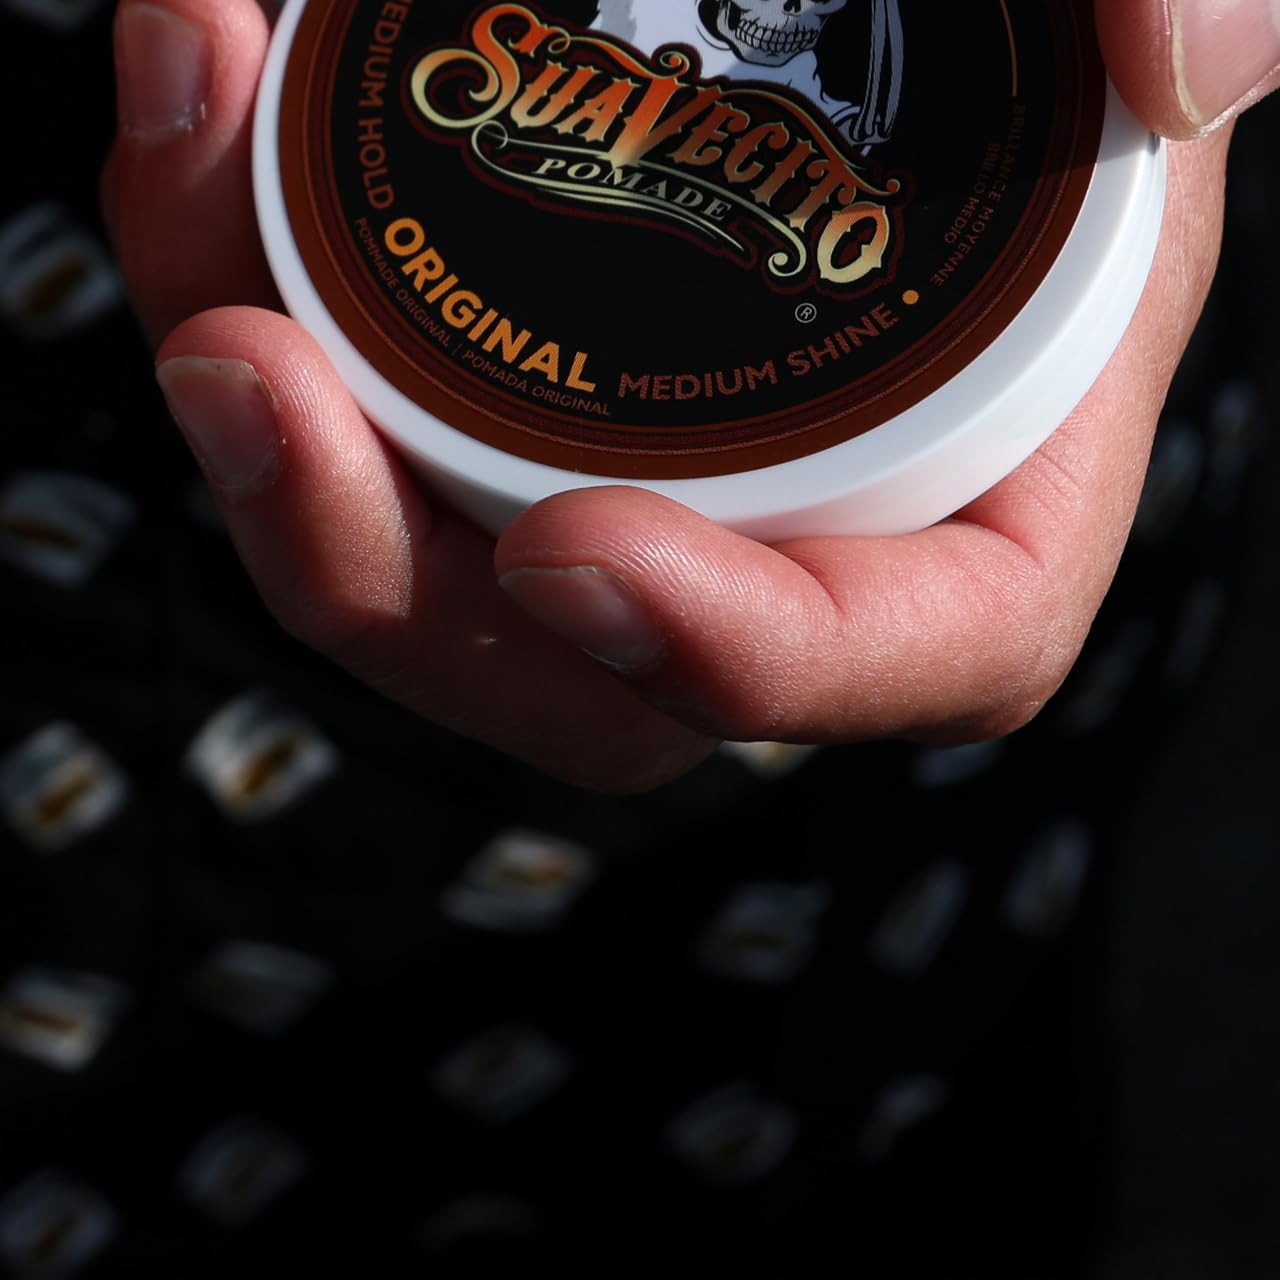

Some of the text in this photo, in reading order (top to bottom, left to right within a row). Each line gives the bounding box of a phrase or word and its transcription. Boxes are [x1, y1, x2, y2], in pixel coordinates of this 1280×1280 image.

[355, 118, 395, 211] HOLD
[410, 2, 901, 284] SUAVECITO
[535, 157, 734, 221] POMADE
[929, 205, 994, 288] MOYENNE
[943, 195, 980, 245] MEDIO
[354, 217, 400, 291] POMMADE
[394, 287, 451, 349] ORIGINAL
[461, 348, 528, 393] POMADA
[530, 385, 612, 417] ORIGINAL
[383, 216, 598, 394] ORIGINAL
[617, 302, 902, 401] MEDIUM SHINE
